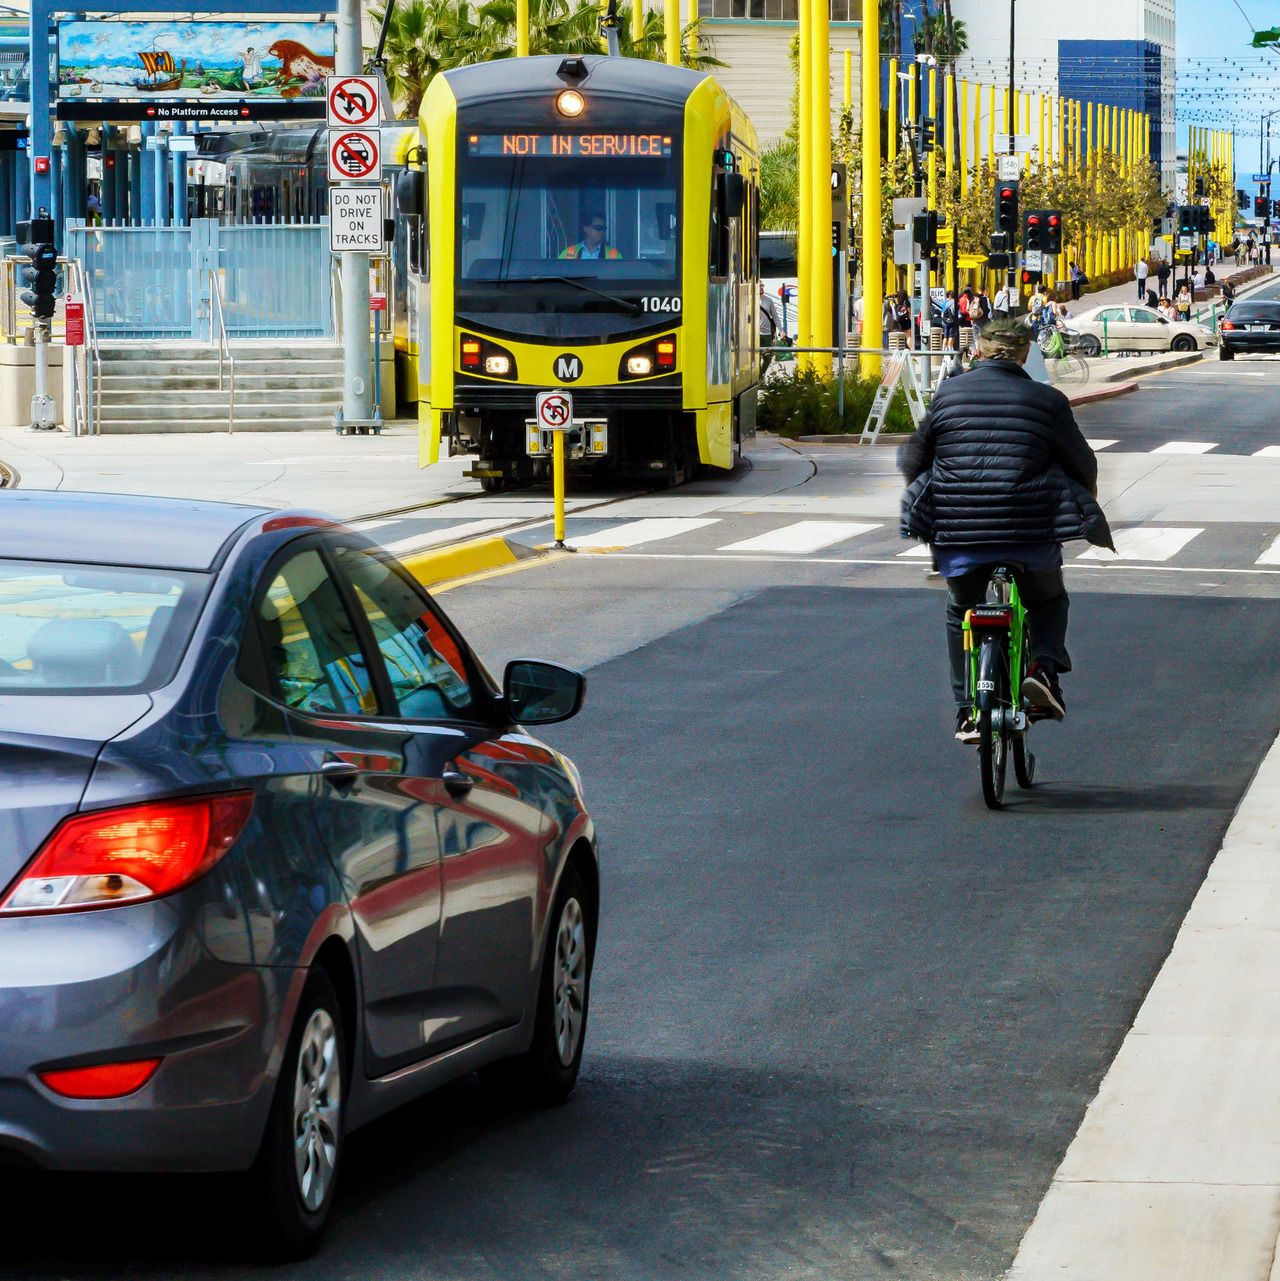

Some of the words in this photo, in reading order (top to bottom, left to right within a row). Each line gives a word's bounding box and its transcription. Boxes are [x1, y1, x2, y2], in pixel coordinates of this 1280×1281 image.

[158, 108, 170, 116] No
[171, 108, 208, 116] Platform
[210, 108, 239, 116] Access
[503, 135, 539, 154] NOT
[552, 135, 571, 154] IN
[579, 135, 662, 155] SERVICE
[335, 194, 350, 205] DO
[356, 194, 377, 205] NOT
[340, 207, 372, 218] DRIVE
[349, 221, 364, 231] ON
[335, 234, 378, 244] TRACKS
[641, 296, 681, 312] 1040
[558, 358, 578, 378] M
